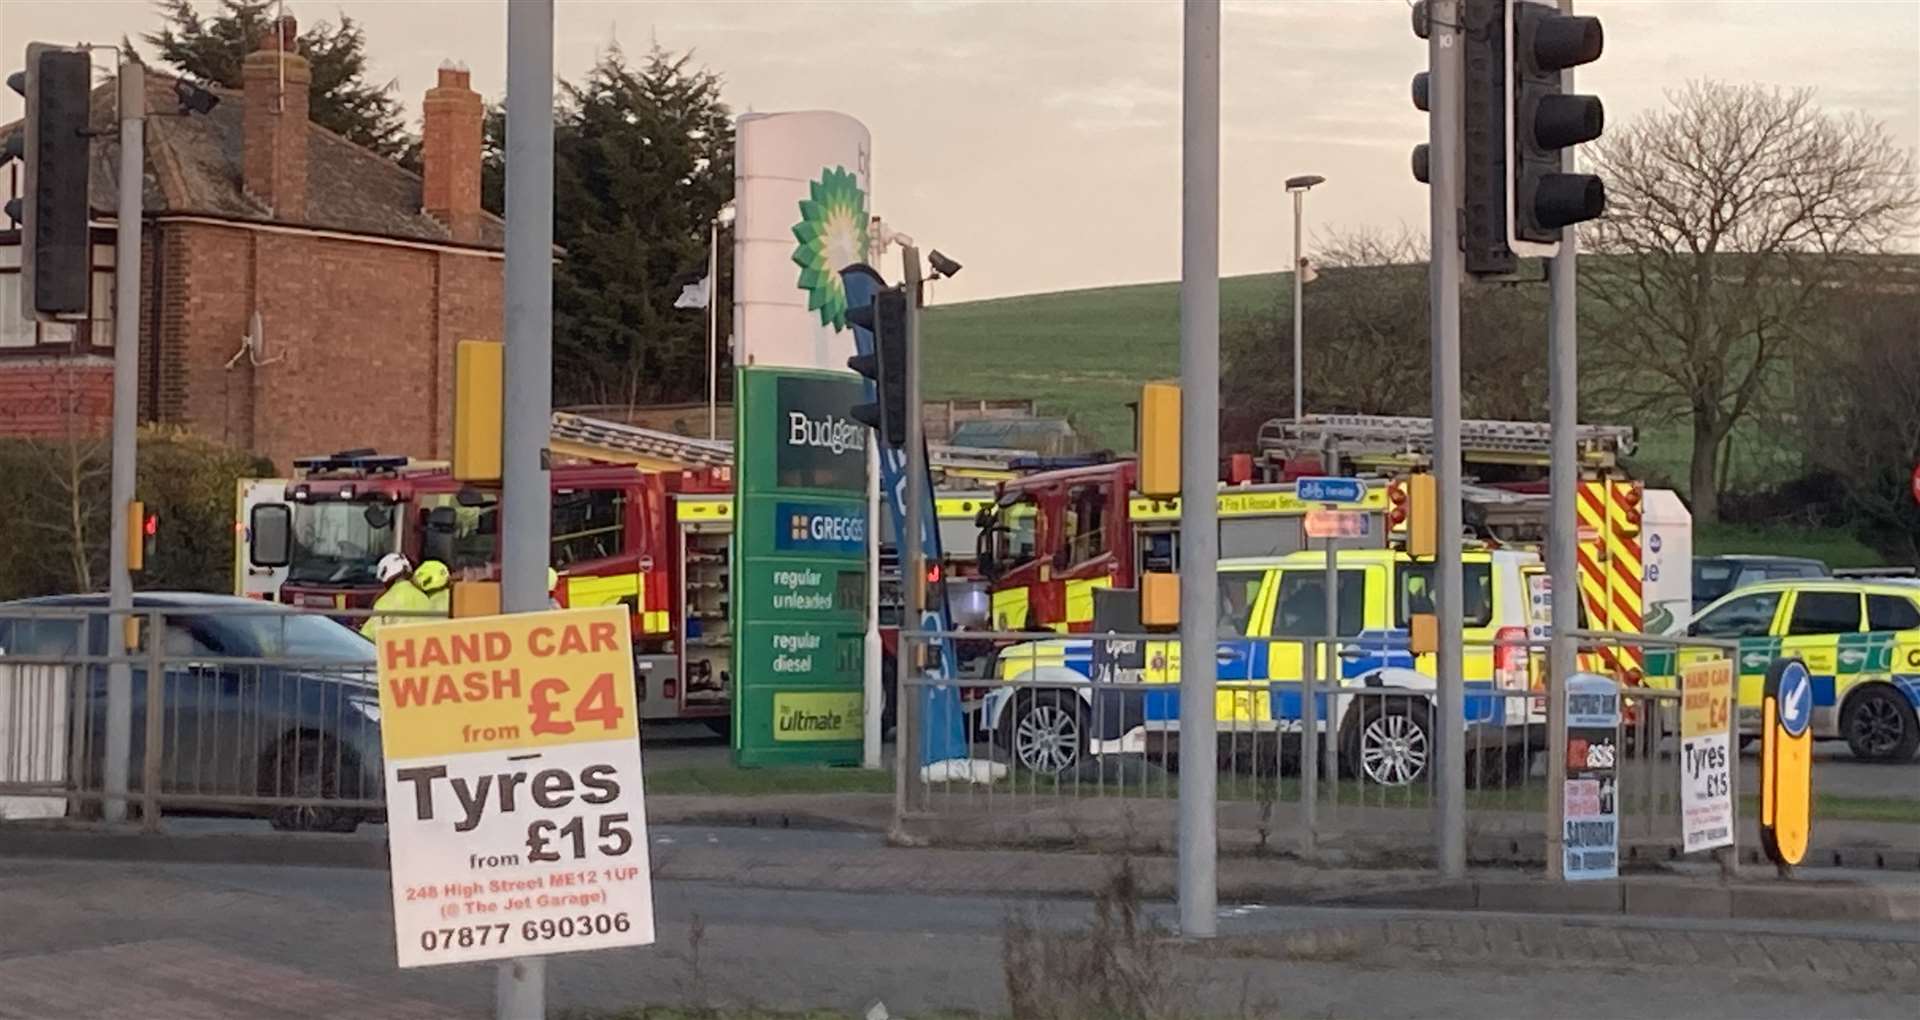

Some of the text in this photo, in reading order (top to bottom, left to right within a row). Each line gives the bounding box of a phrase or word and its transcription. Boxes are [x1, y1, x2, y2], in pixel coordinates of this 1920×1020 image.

[789, 412, 865, 454] Budgens
[811, 515, 865, 541] GREGGS
[773, 568, 822, 589] regular
[773, 590, 833, 609] unleaded
[386, 621, 620, 670] HAND CAR
[773, 631, 820, 653] regular
[773, 654, 812, 672] diesel
[389, 668, 521, 708] WASH
[462, 672, 624, 743] from £4
[1685, 743, 1725, 780] Tyres
[397, 764, 620, 832] Tyres
[1707, 772, 1728, 797] £15
[469, 812, 633, 870] from £15
[405, 866, 639, 901] 248 High Street ME12 1UP
[464, 898, 496, 915] The
[503, 895, 531, 911] Jet
[536, 888, 607, 908] Garage)
[421, 911, 631, 953] 07877 690306
